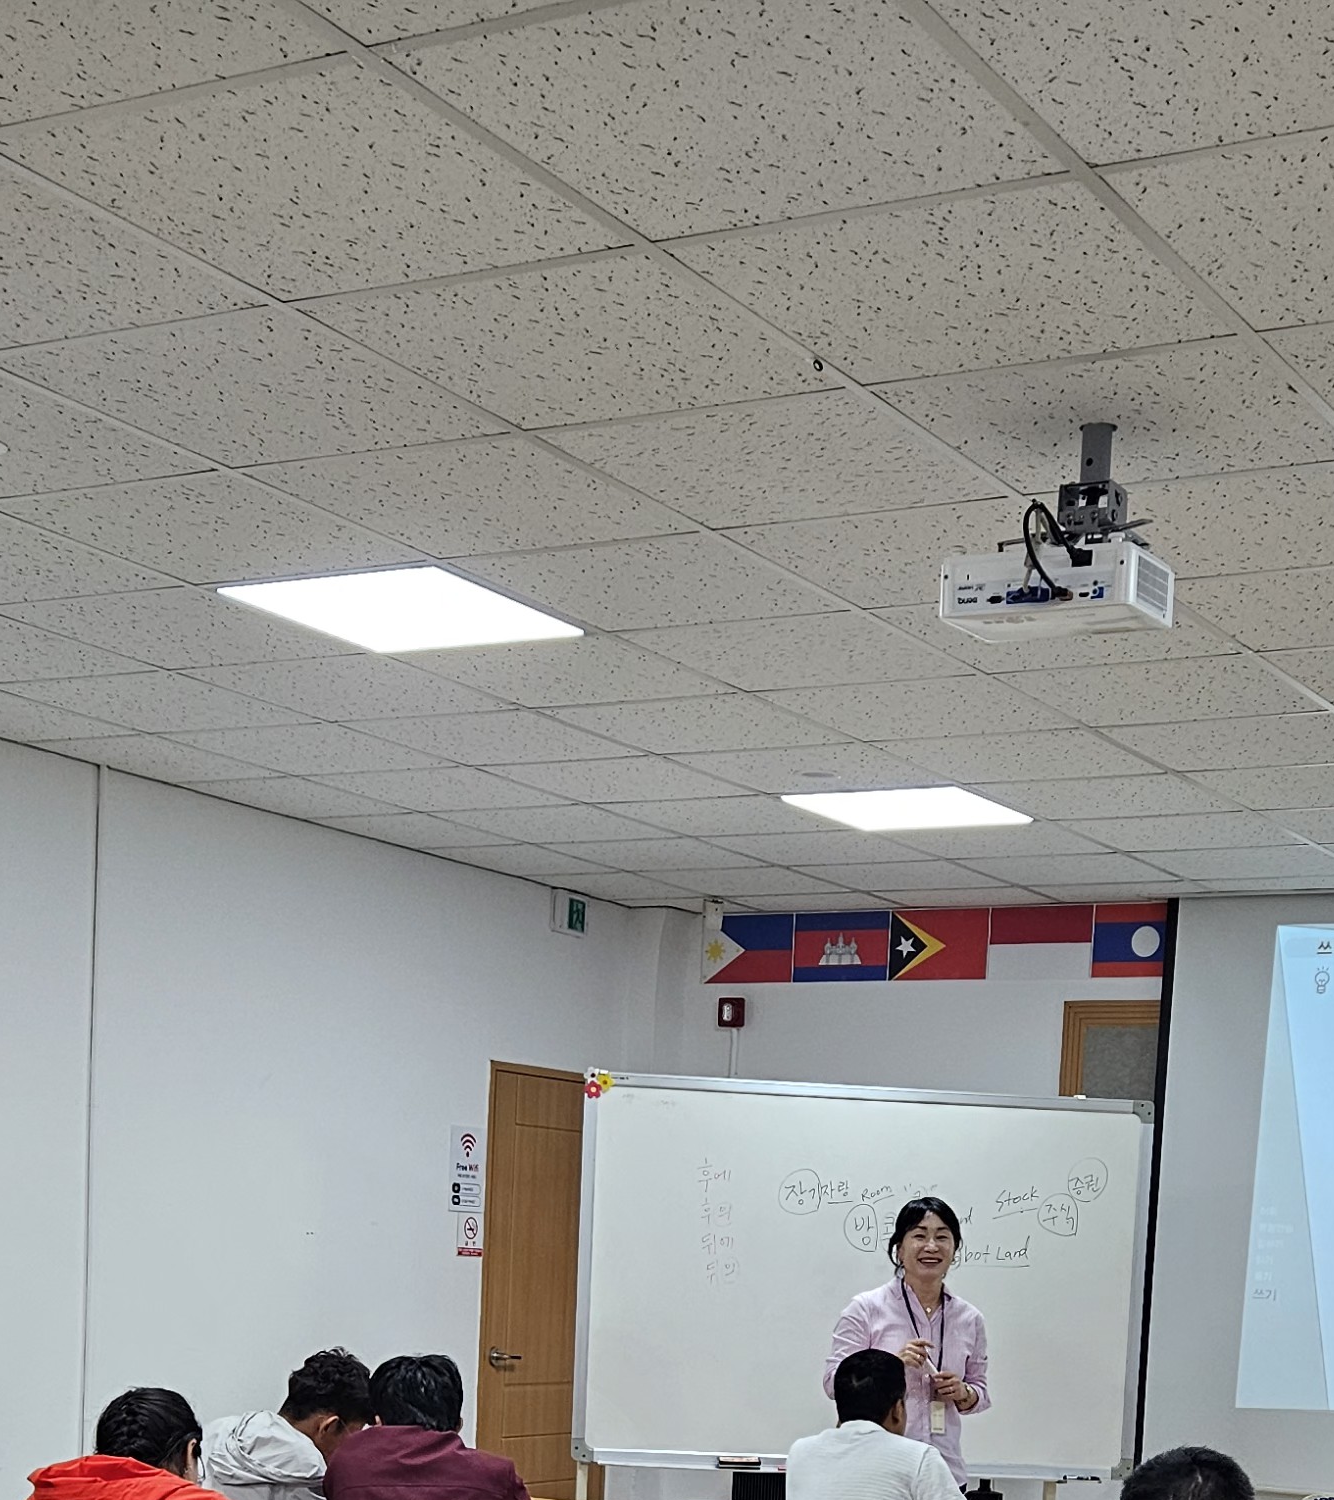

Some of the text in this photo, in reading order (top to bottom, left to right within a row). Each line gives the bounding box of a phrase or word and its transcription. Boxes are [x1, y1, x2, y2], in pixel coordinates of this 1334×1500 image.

[456, 1162, 468, 1172] Free
[861, 1184, 893, 1202] Room
[995, 1185, 1040, 1212] Stock
[1042, 1203, 1075, 1231] 주식
[995, 1236, 1030, 1262] Land
[1252, 1289, 1276, 1301] 쓰기
